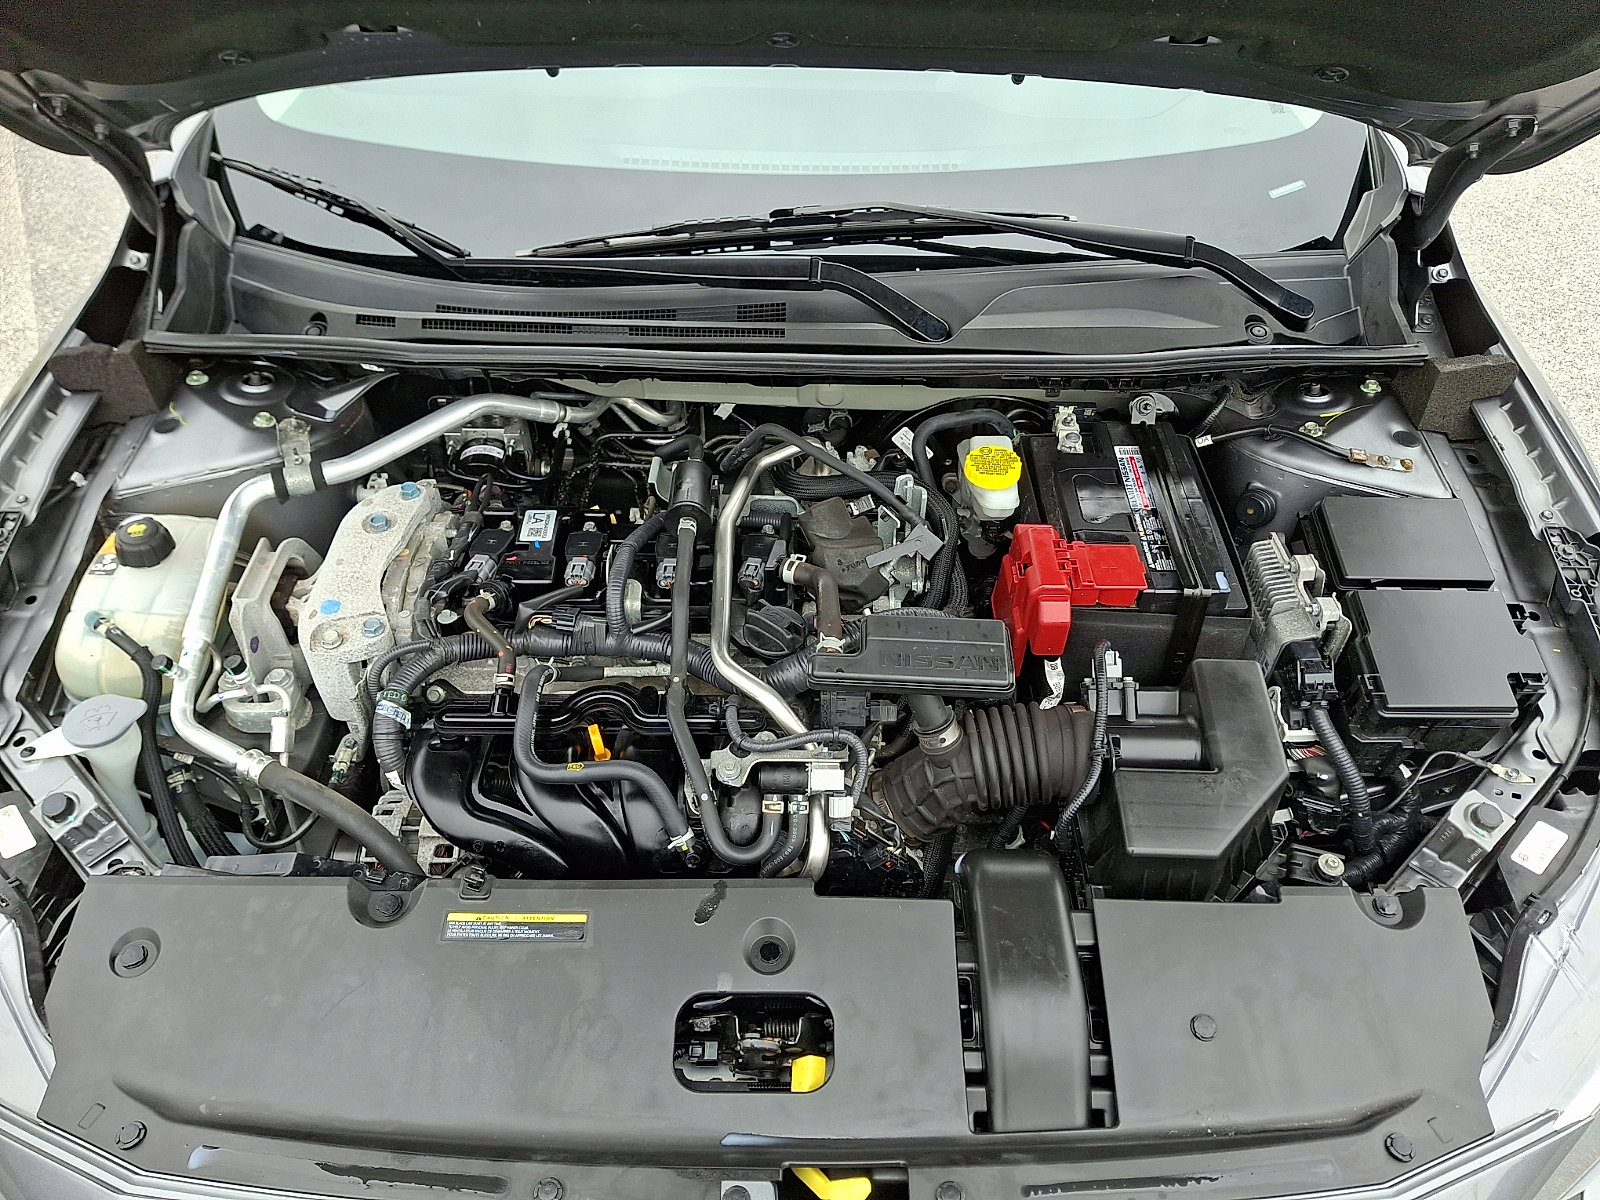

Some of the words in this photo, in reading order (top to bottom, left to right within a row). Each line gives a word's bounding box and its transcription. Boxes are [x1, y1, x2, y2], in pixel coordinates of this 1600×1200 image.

[1118, 457, 1131, 482] NISSAN
[532, 513, 545, 524] LA
[881, 652, 1002, 673] NISSAN
